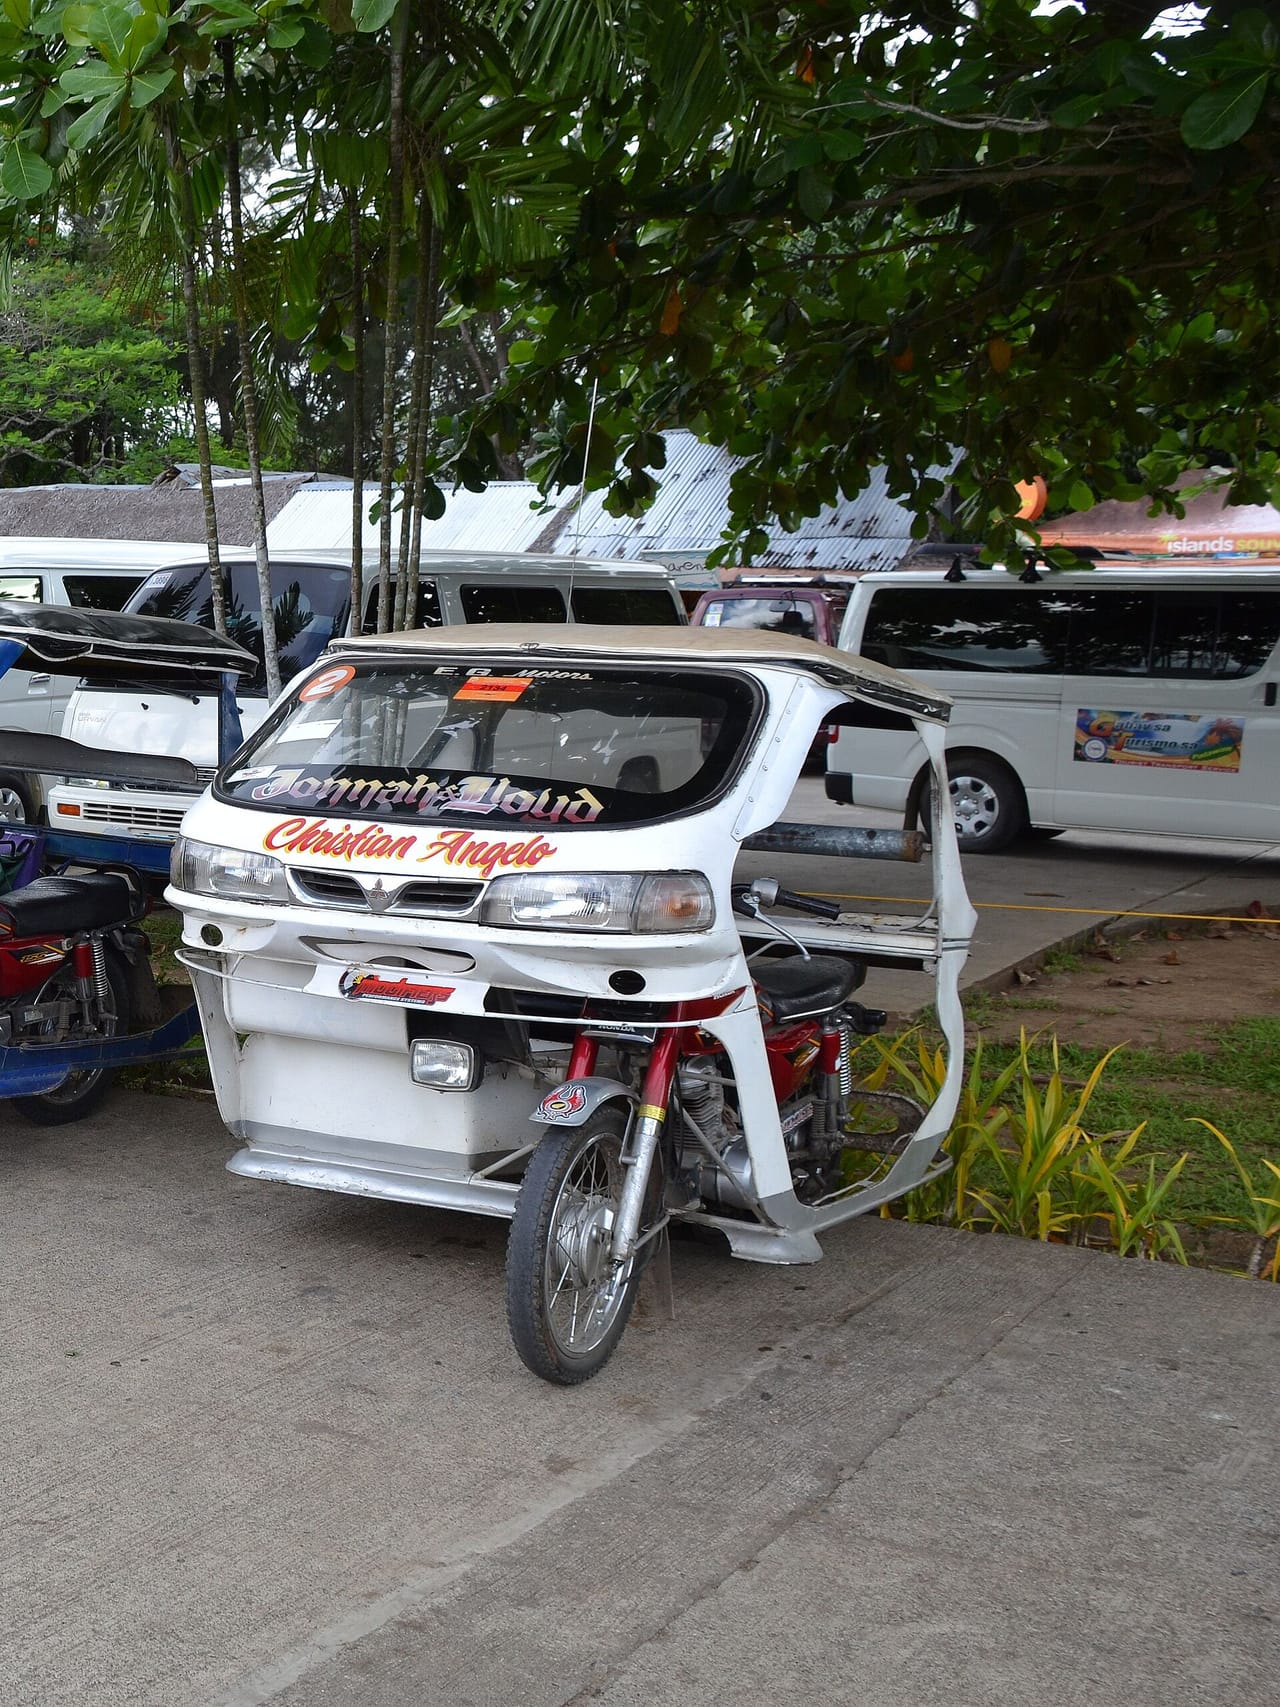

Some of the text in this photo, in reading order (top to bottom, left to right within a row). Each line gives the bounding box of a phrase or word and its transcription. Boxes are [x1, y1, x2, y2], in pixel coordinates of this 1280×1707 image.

[1167, 536, 1233, 553] islands
[306, 668, 349, 697] 2
[504, 669, 594, 680] Motors
[1112, 732, 1178, 751] Turismo
[263, 817, 558, 880] Christian Angelo
